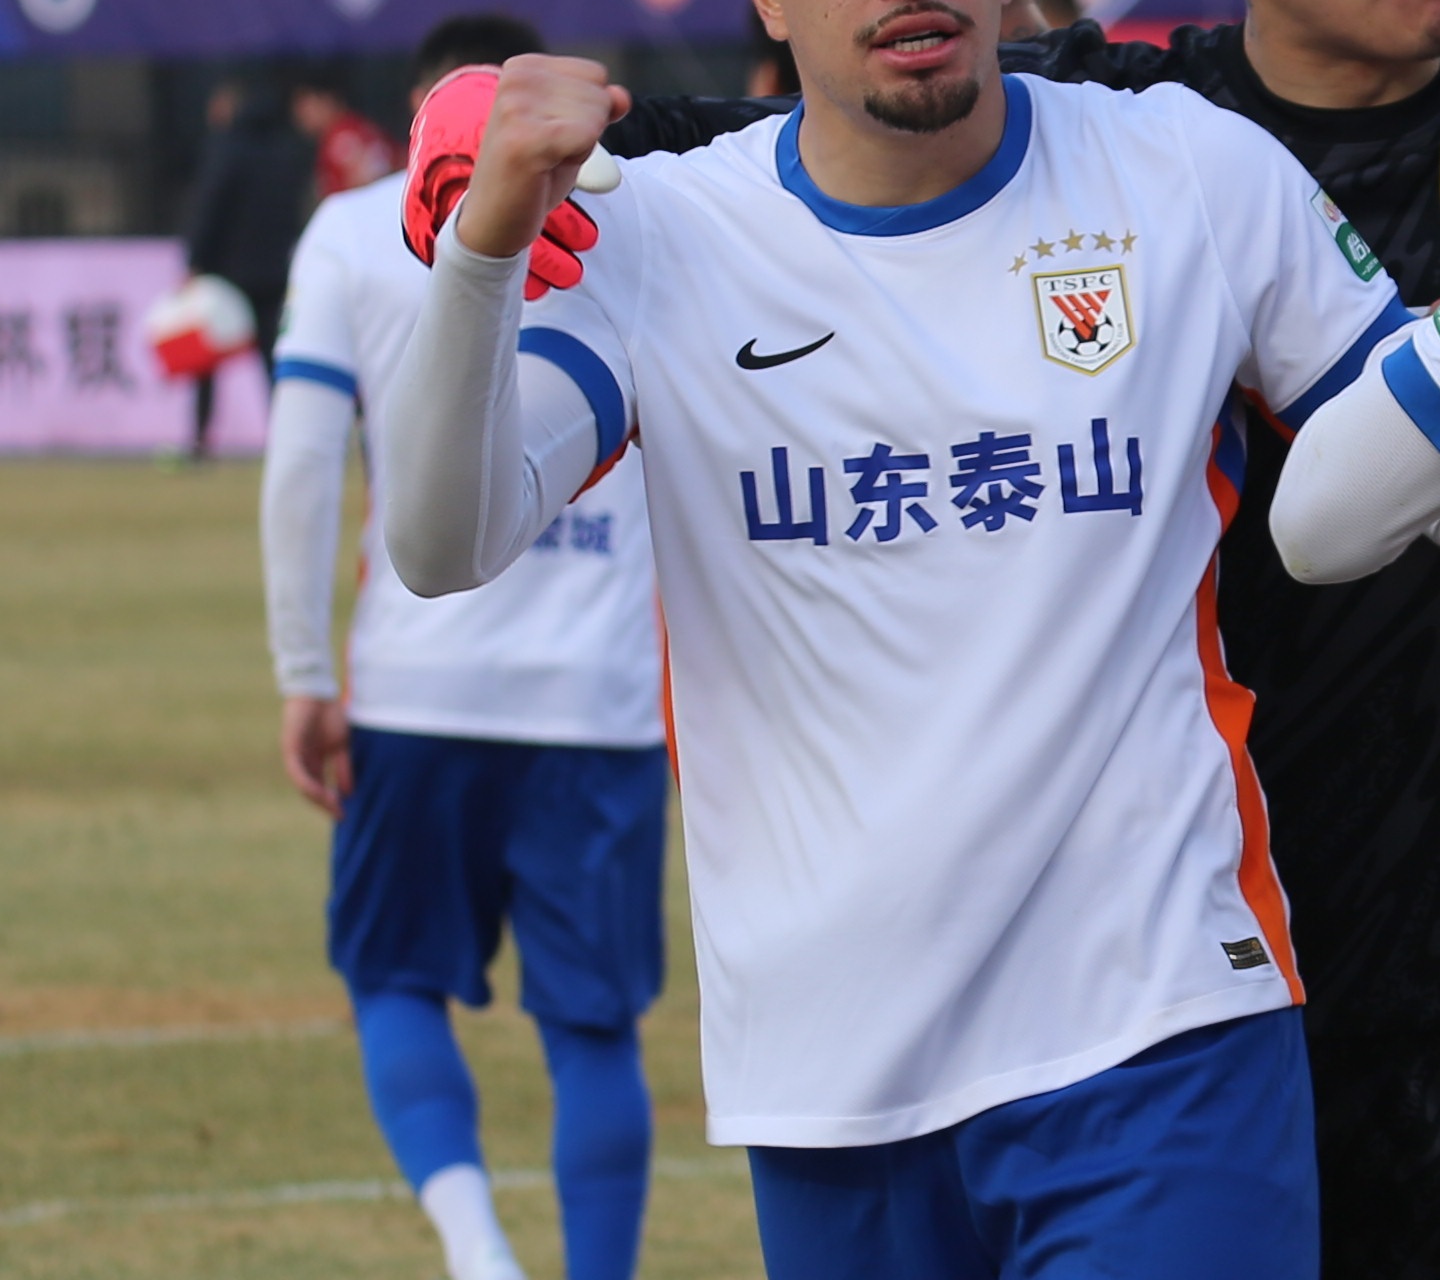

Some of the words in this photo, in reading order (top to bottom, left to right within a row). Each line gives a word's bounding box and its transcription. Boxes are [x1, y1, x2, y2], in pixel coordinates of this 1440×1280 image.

[1043, 273, 1115, 292] TSFC
[740, 417, 1144, 547] 山东泰山
